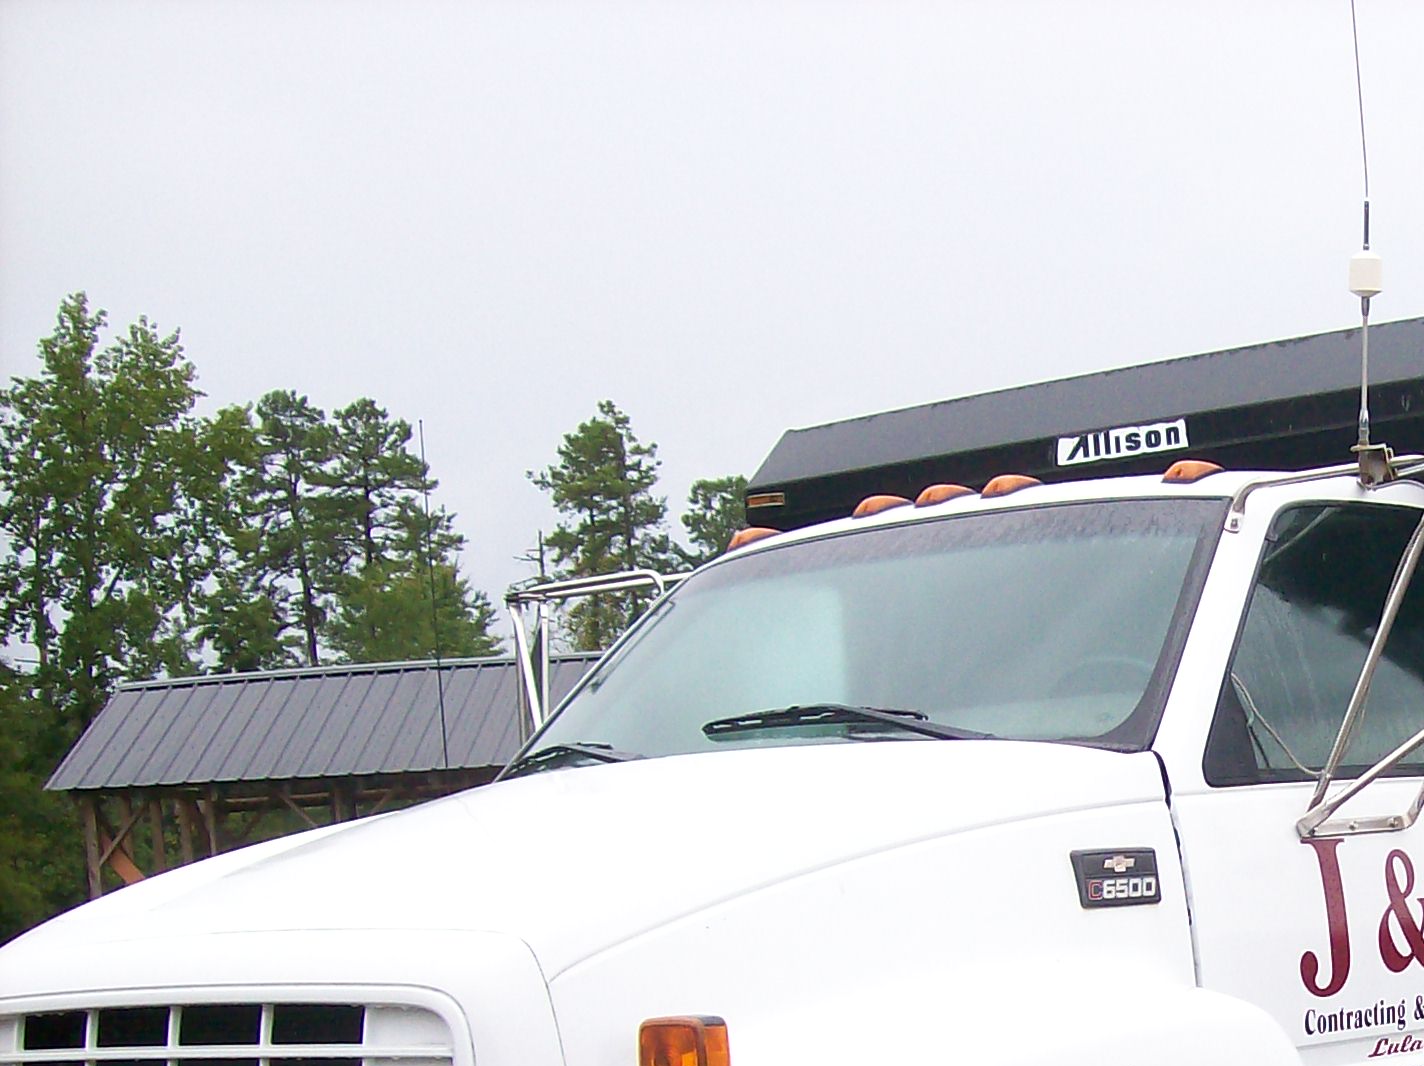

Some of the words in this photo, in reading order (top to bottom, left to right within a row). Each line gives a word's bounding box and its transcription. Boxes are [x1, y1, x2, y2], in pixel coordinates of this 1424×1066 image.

[1066, 426, 1180, 461] Allison
[1087, 877, 1157, 900] C6500
[1300, 838, 1351, 997] J
[1304, 999, 1407, 1036] Contracting
